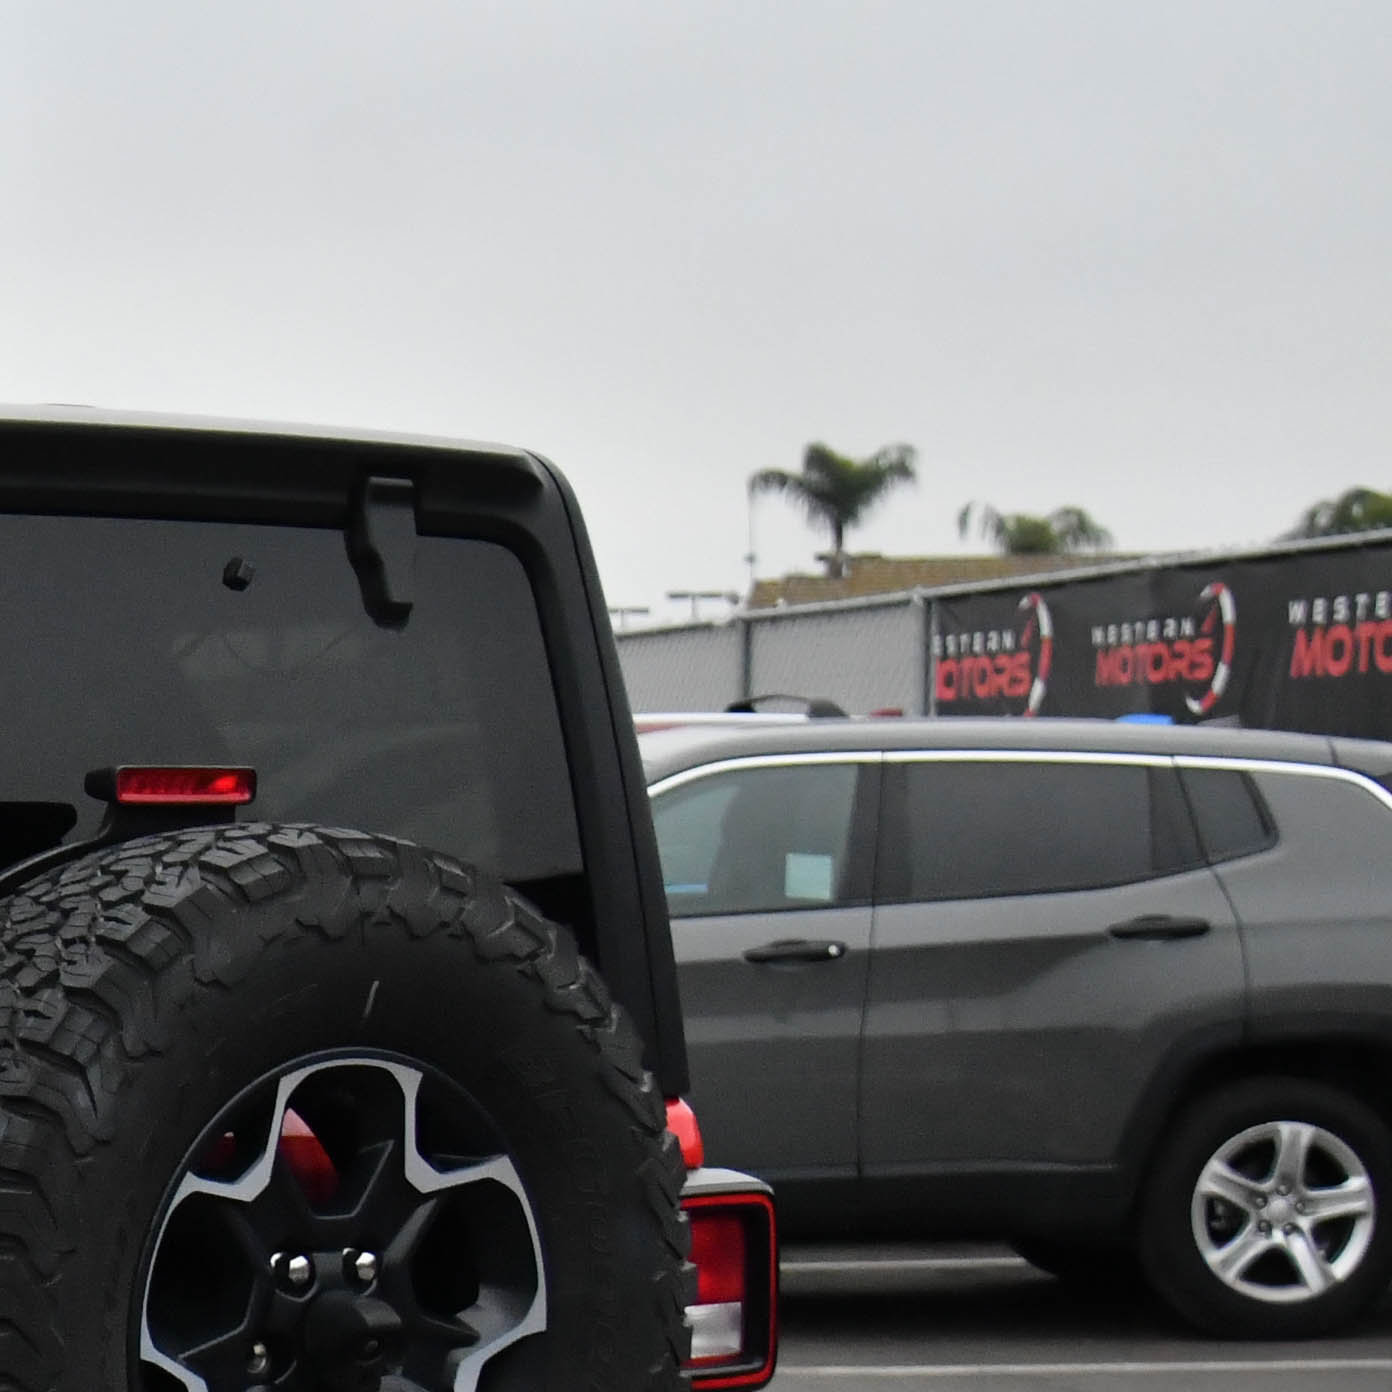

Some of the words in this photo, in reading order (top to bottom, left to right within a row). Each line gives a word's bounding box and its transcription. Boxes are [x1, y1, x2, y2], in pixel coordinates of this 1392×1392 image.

[1091, 617, 1196, 647] WESTERN
[934, 651, 1031, 702] OTORS
[1096, 636, 1214, 687] MOTORS
